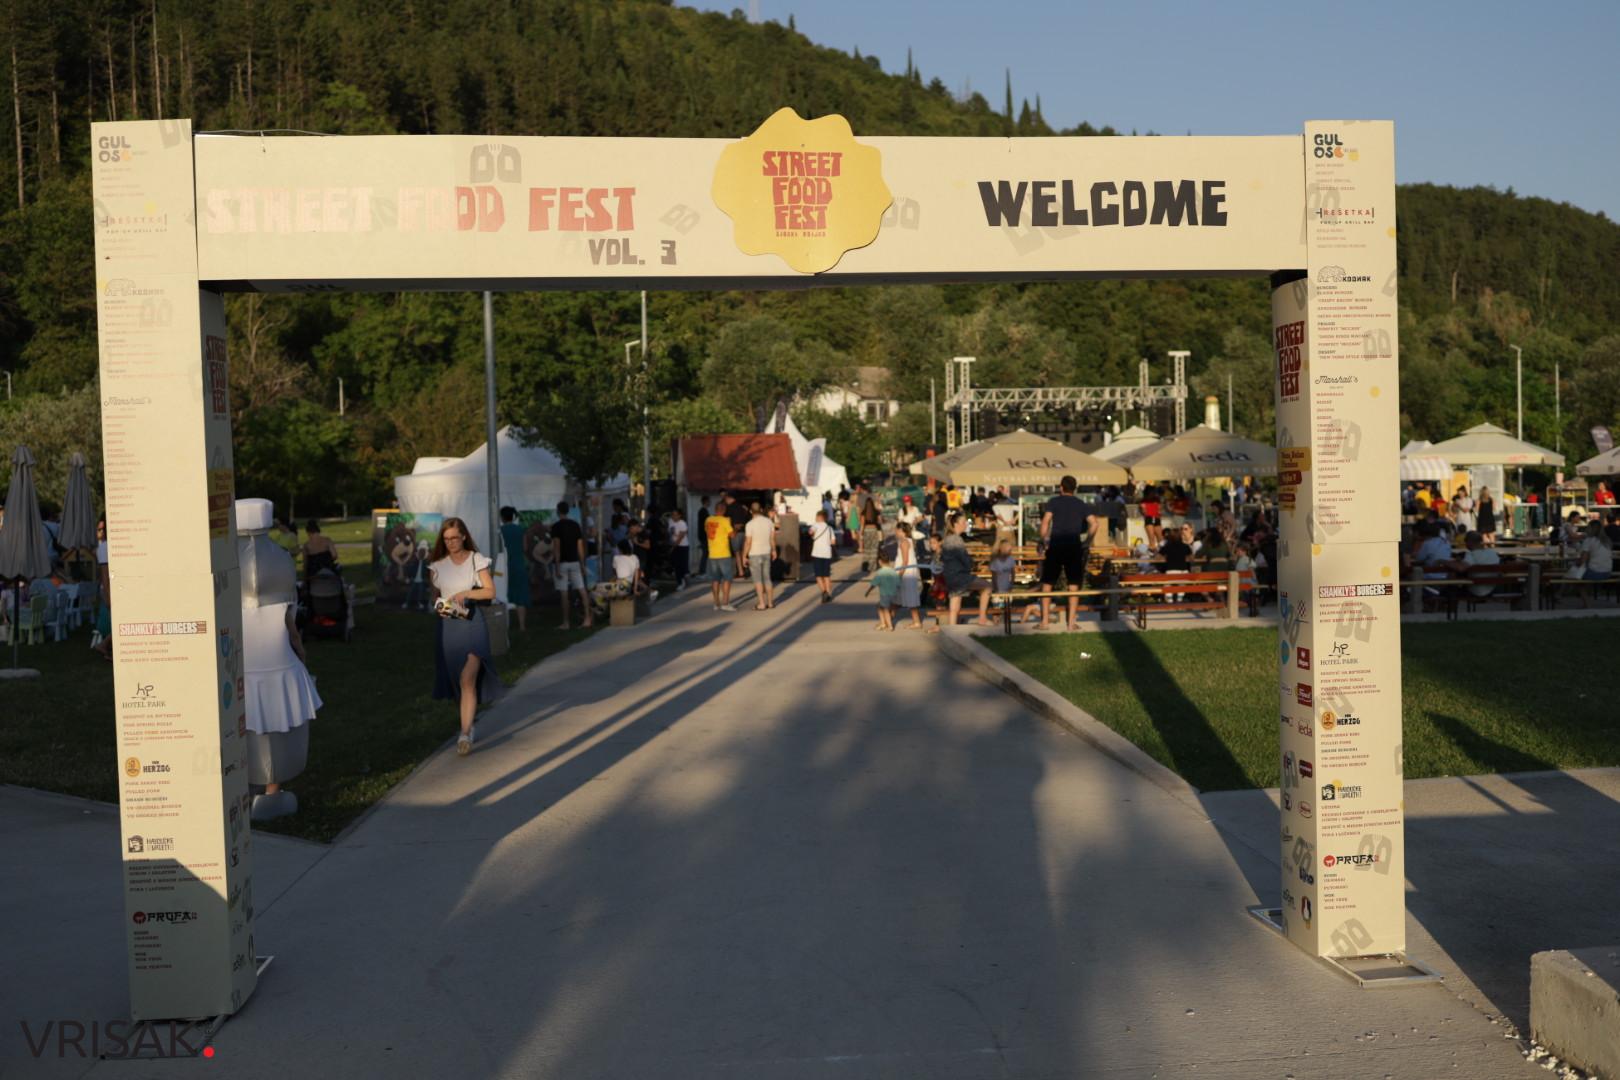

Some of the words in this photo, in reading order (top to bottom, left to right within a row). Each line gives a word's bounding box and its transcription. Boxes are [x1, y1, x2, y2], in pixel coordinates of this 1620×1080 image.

[98, 136, 131, 149] GUL
[1314, 134, 1343, 145] GUL
[763, 151, 843, 176] STREET
[772, 177, 833, 205] FOOD
[206, 186, 374, 233] STREET
[399, 185, 506, 233] FOOD
[528, 187, 636, 232] FEST
[977, 180, 1228, 227] WELCOME
[774, 205, 828, 230] FEST
[588, 238, 646, 265] VOL.
[661, 240, 677, 265] 3
[1276, 321, 1305, 350] STREET
[1280, 346, 1301, 375] FOOD
[1281, 373, 1300, 397] FEST
[1008, 458, 1066, 469] leda
[1188, 451, 1250, 462] leda
[1356, 584, 1386, 596] BURGERS
[1336, 718, 1360, 726] HERZOG
[143, 765, 170, 773] HERZOG
